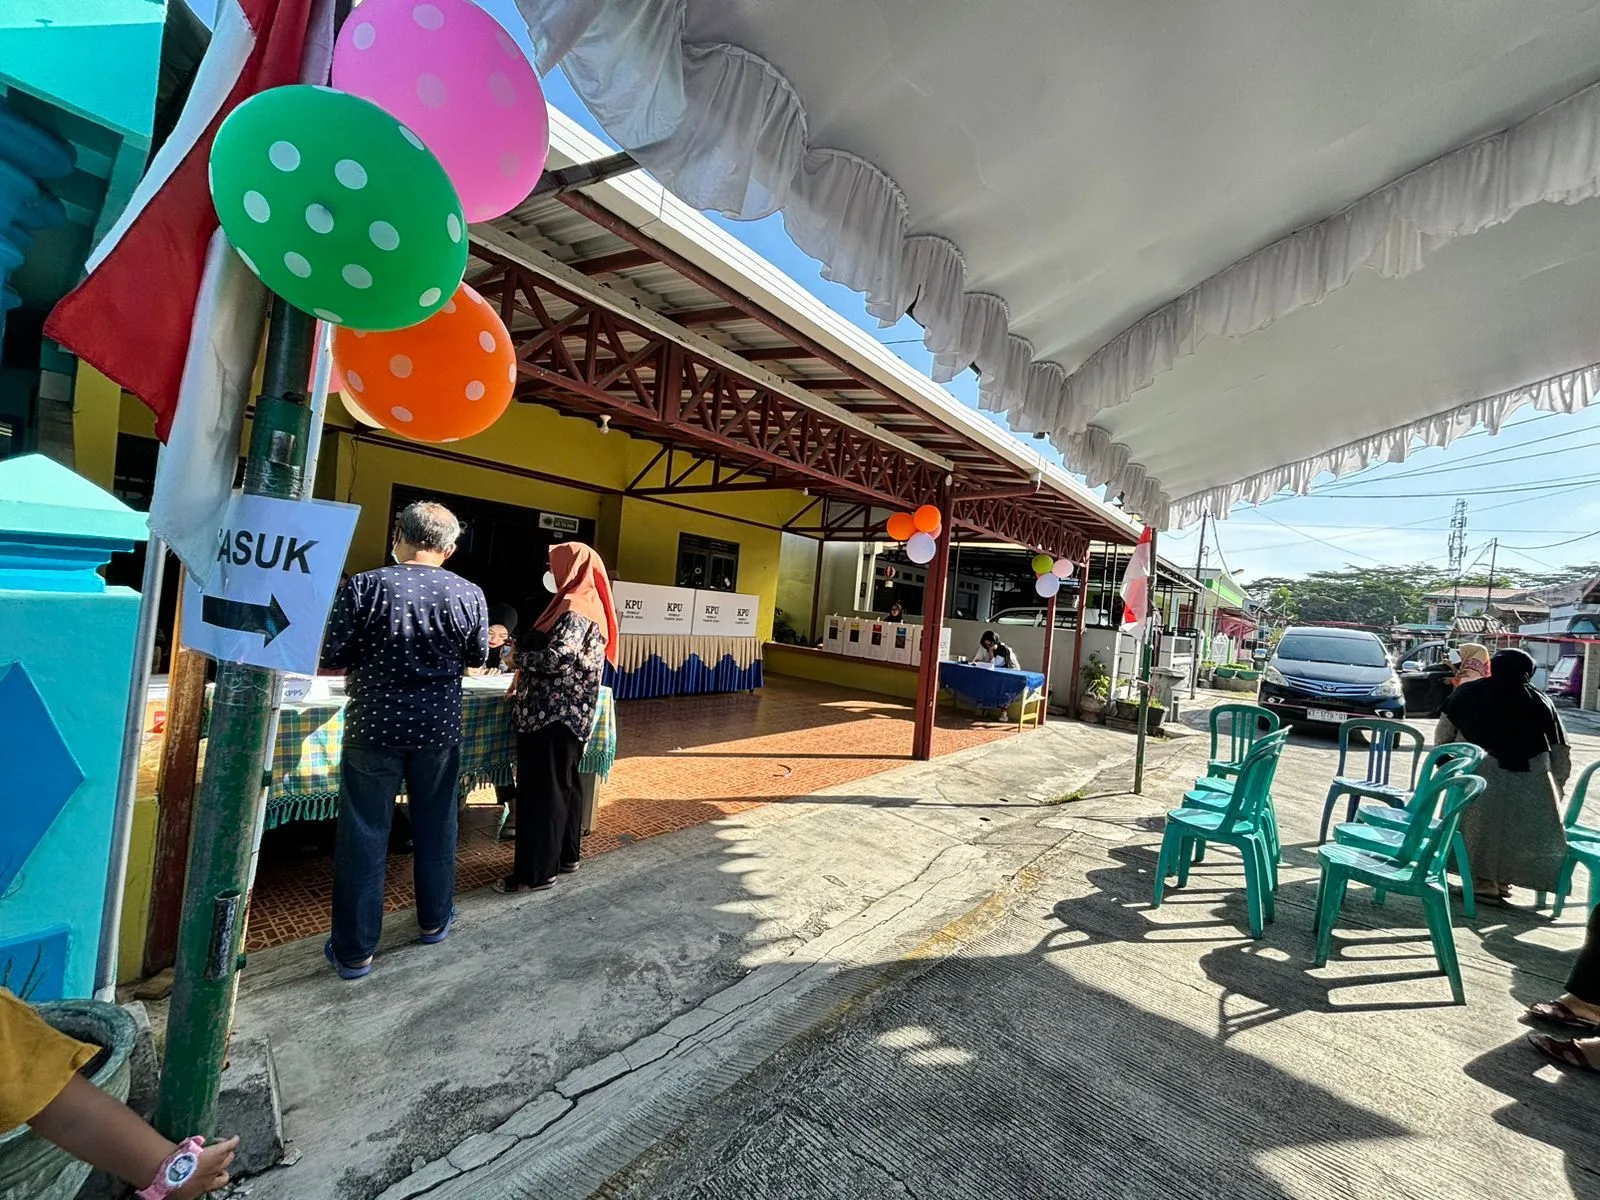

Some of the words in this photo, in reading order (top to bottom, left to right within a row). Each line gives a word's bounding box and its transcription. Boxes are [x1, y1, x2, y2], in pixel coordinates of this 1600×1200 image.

[217, 528, 320, 574] ASUK
[625, 600, 643, 610] KPU
[667, 603, 683, 612] KPU
[705, 605, 719, 615] KPU
[737, 608, 750, 617] KPU
